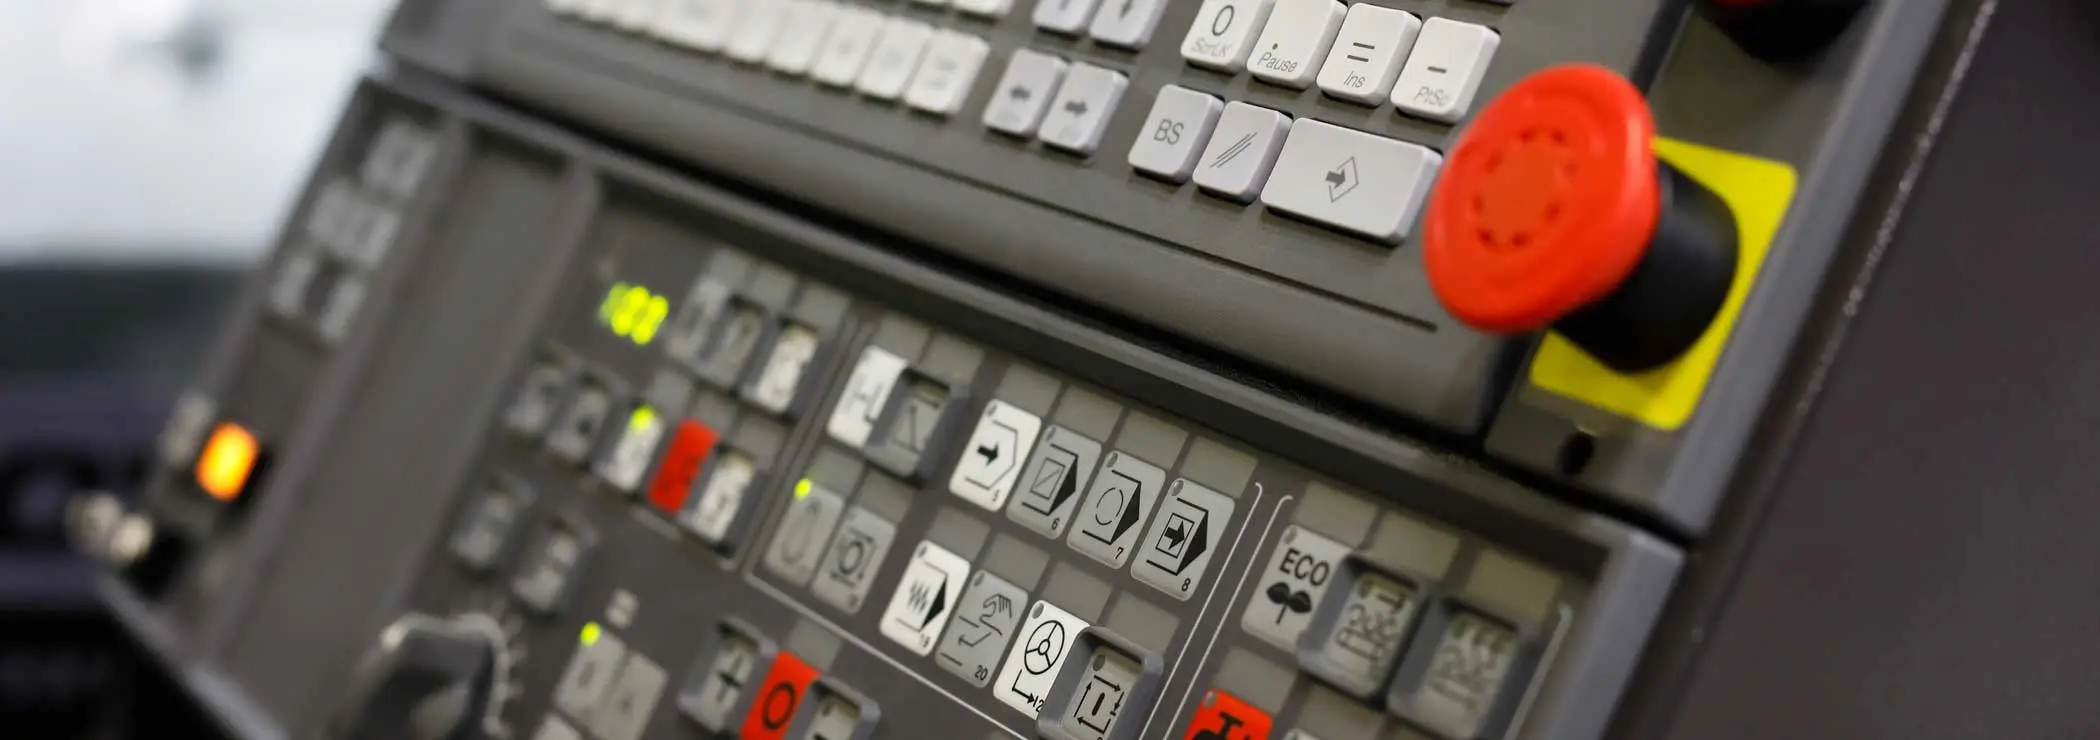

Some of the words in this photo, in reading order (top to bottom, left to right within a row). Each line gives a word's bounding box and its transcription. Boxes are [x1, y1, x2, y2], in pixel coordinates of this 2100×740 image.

[1256, 51, 1298, 72] Pause
[1343, 70, 1366, 88] Ins
[1153, 118, 1185, 145] BS
[1051, 516, 1060, 530] 6
[1113, 547, 1124, 560] 7
[1278, 547, 1330, 586] ECO
[1181, 577, 1191, 592] 8
[974, 664, 989, 681] 20
